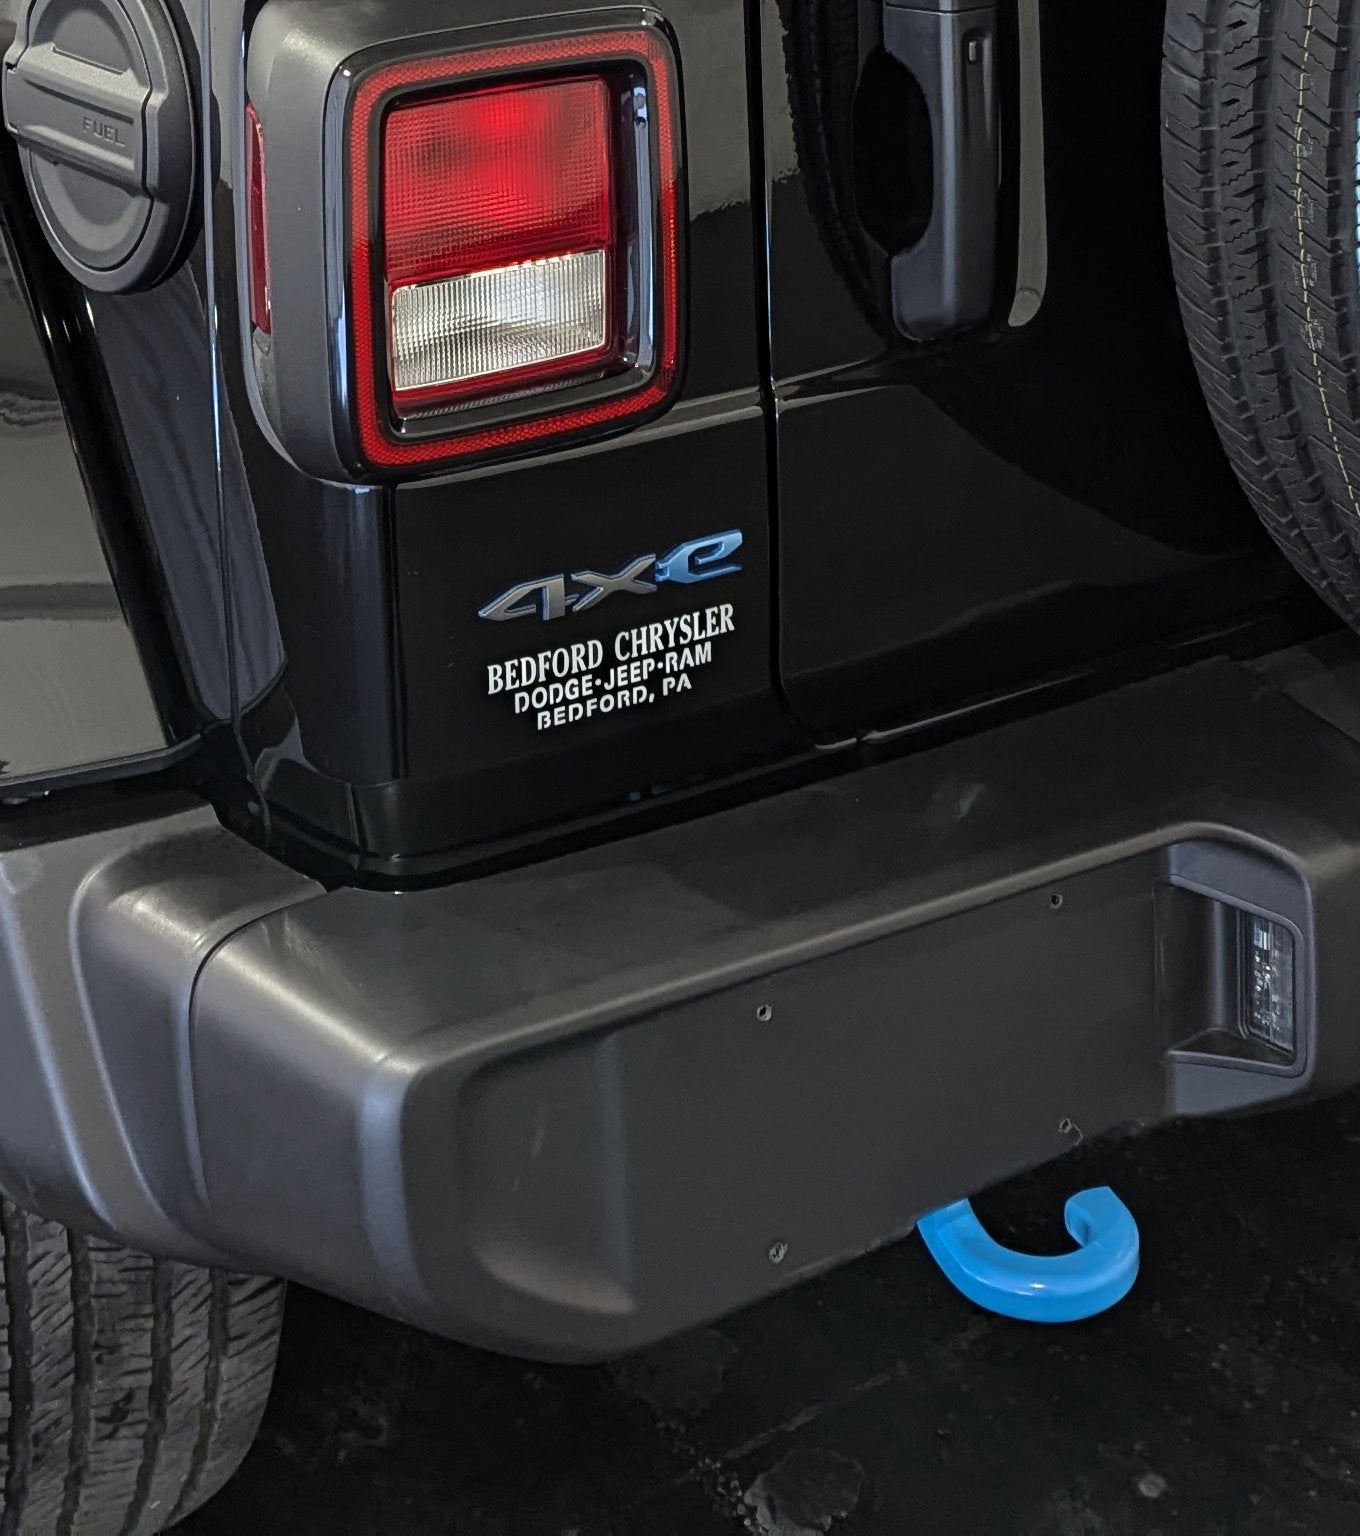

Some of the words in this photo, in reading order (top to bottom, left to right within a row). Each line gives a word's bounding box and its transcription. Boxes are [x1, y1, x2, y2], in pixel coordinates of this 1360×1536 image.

[82, 115, 126, 149] FUEL
[486, 638, 604, 696] BEDFORD
[614, 602, 736, 663] CHRYSLER
[536, 684, 656, 732] BEDFORD,
[662, 671, 693, 699] PA
